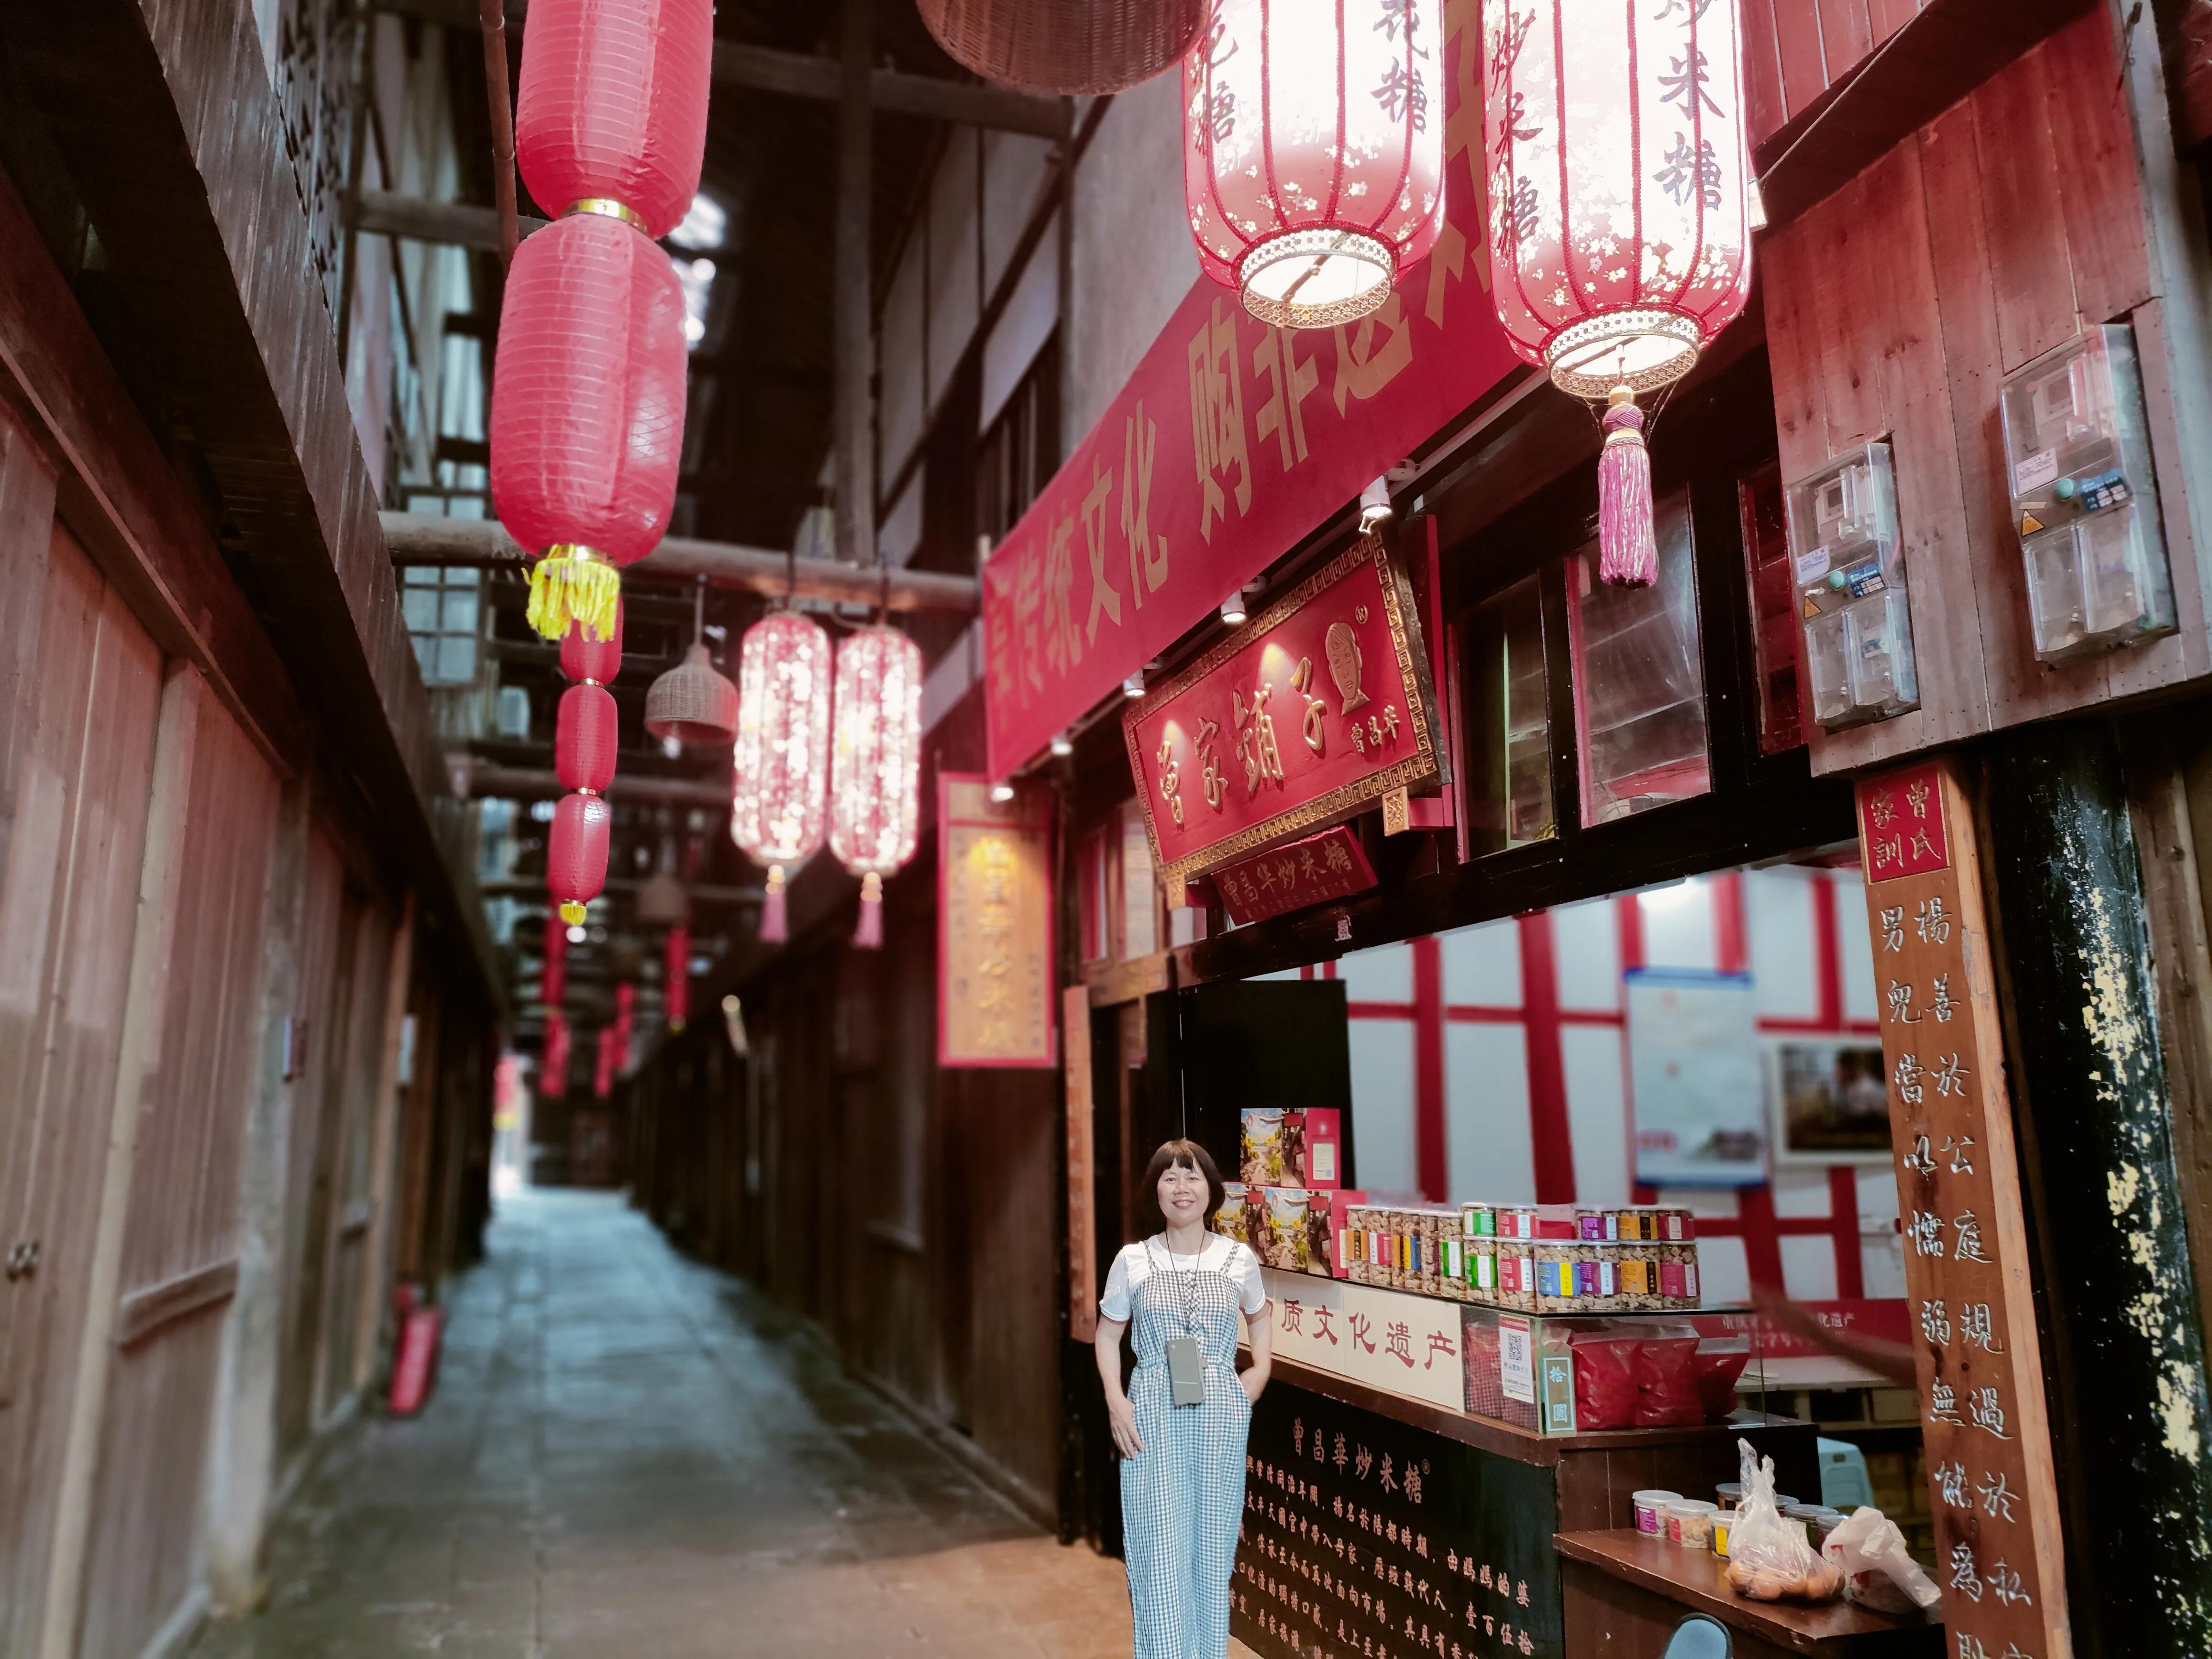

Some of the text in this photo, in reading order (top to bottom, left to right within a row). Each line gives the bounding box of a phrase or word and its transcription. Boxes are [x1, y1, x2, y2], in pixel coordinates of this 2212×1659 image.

[1266, 1298, 1456, 1370] 质文化遗产
[1293, 1416, 1422, 1504] 曾昌華炒米糖
